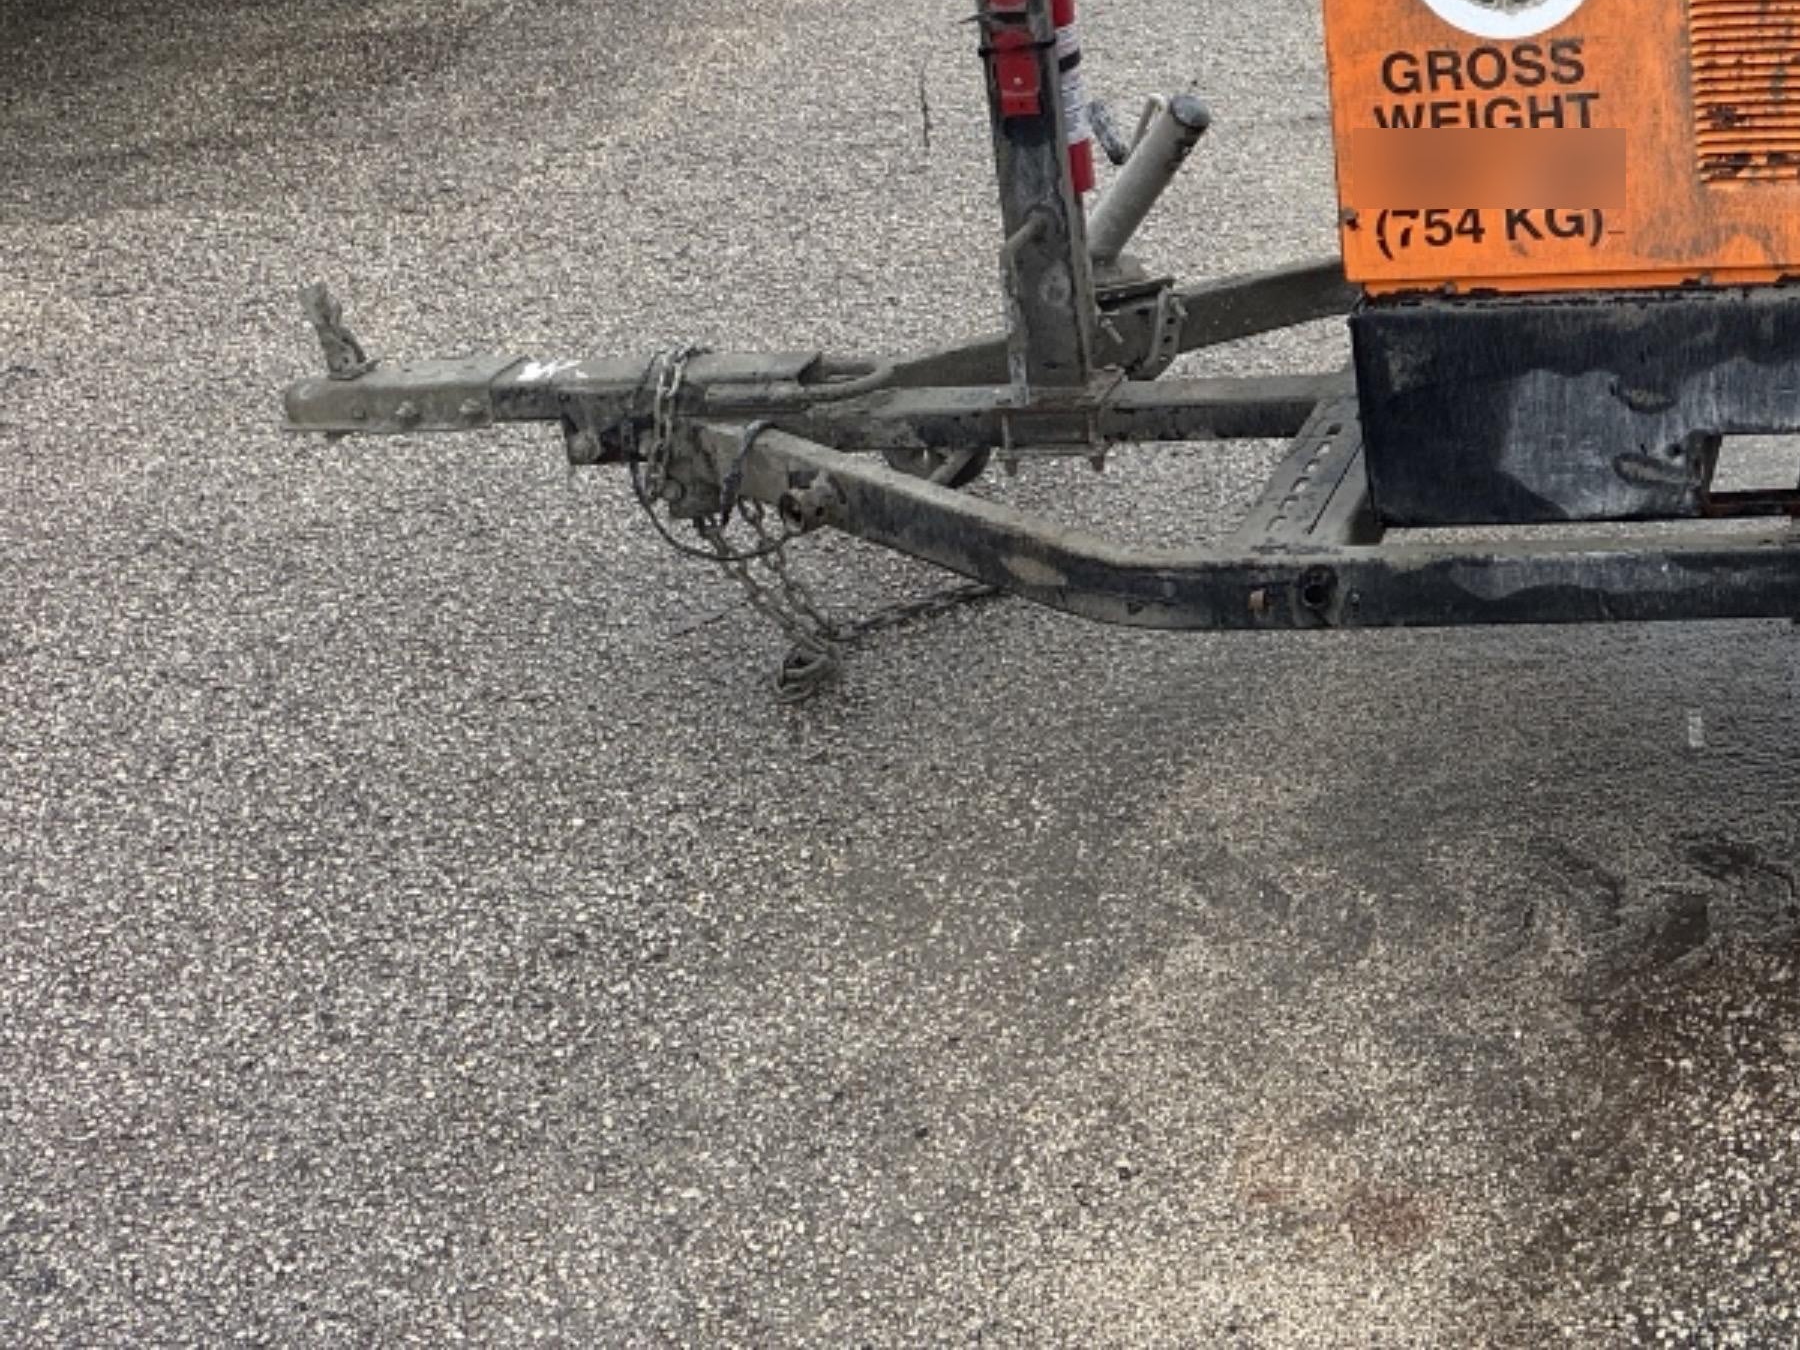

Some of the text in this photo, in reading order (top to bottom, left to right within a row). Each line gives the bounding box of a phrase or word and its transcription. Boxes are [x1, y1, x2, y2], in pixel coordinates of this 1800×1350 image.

[1381, 37, 1585, 95] GROSS
[1376, 208, 1604, 261] (754 KG)
